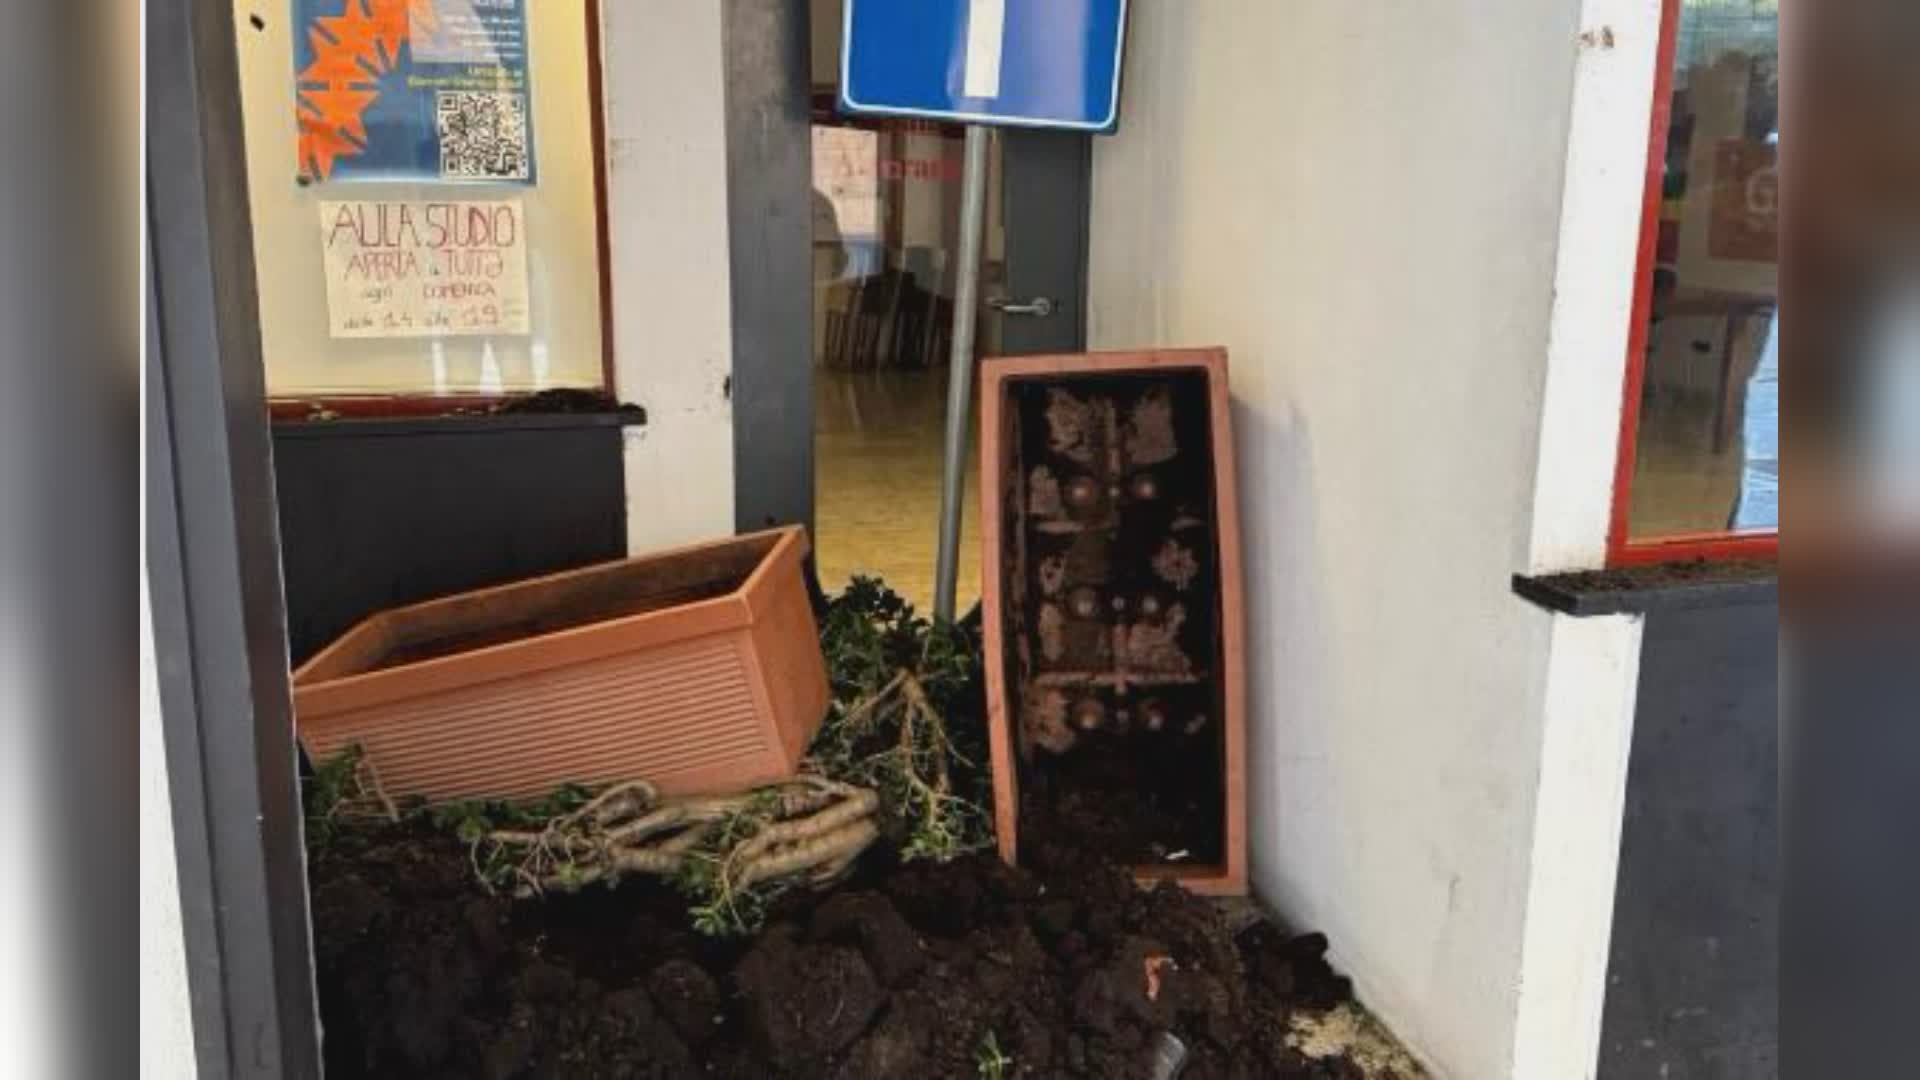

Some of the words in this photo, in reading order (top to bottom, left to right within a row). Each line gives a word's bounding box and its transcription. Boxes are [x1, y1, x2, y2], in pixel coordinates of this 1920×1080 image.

[328, 203, 421, 248] AULA
[426, 203, 515, 248] STUDIO
[344, 251, 419, 281] APERTA
